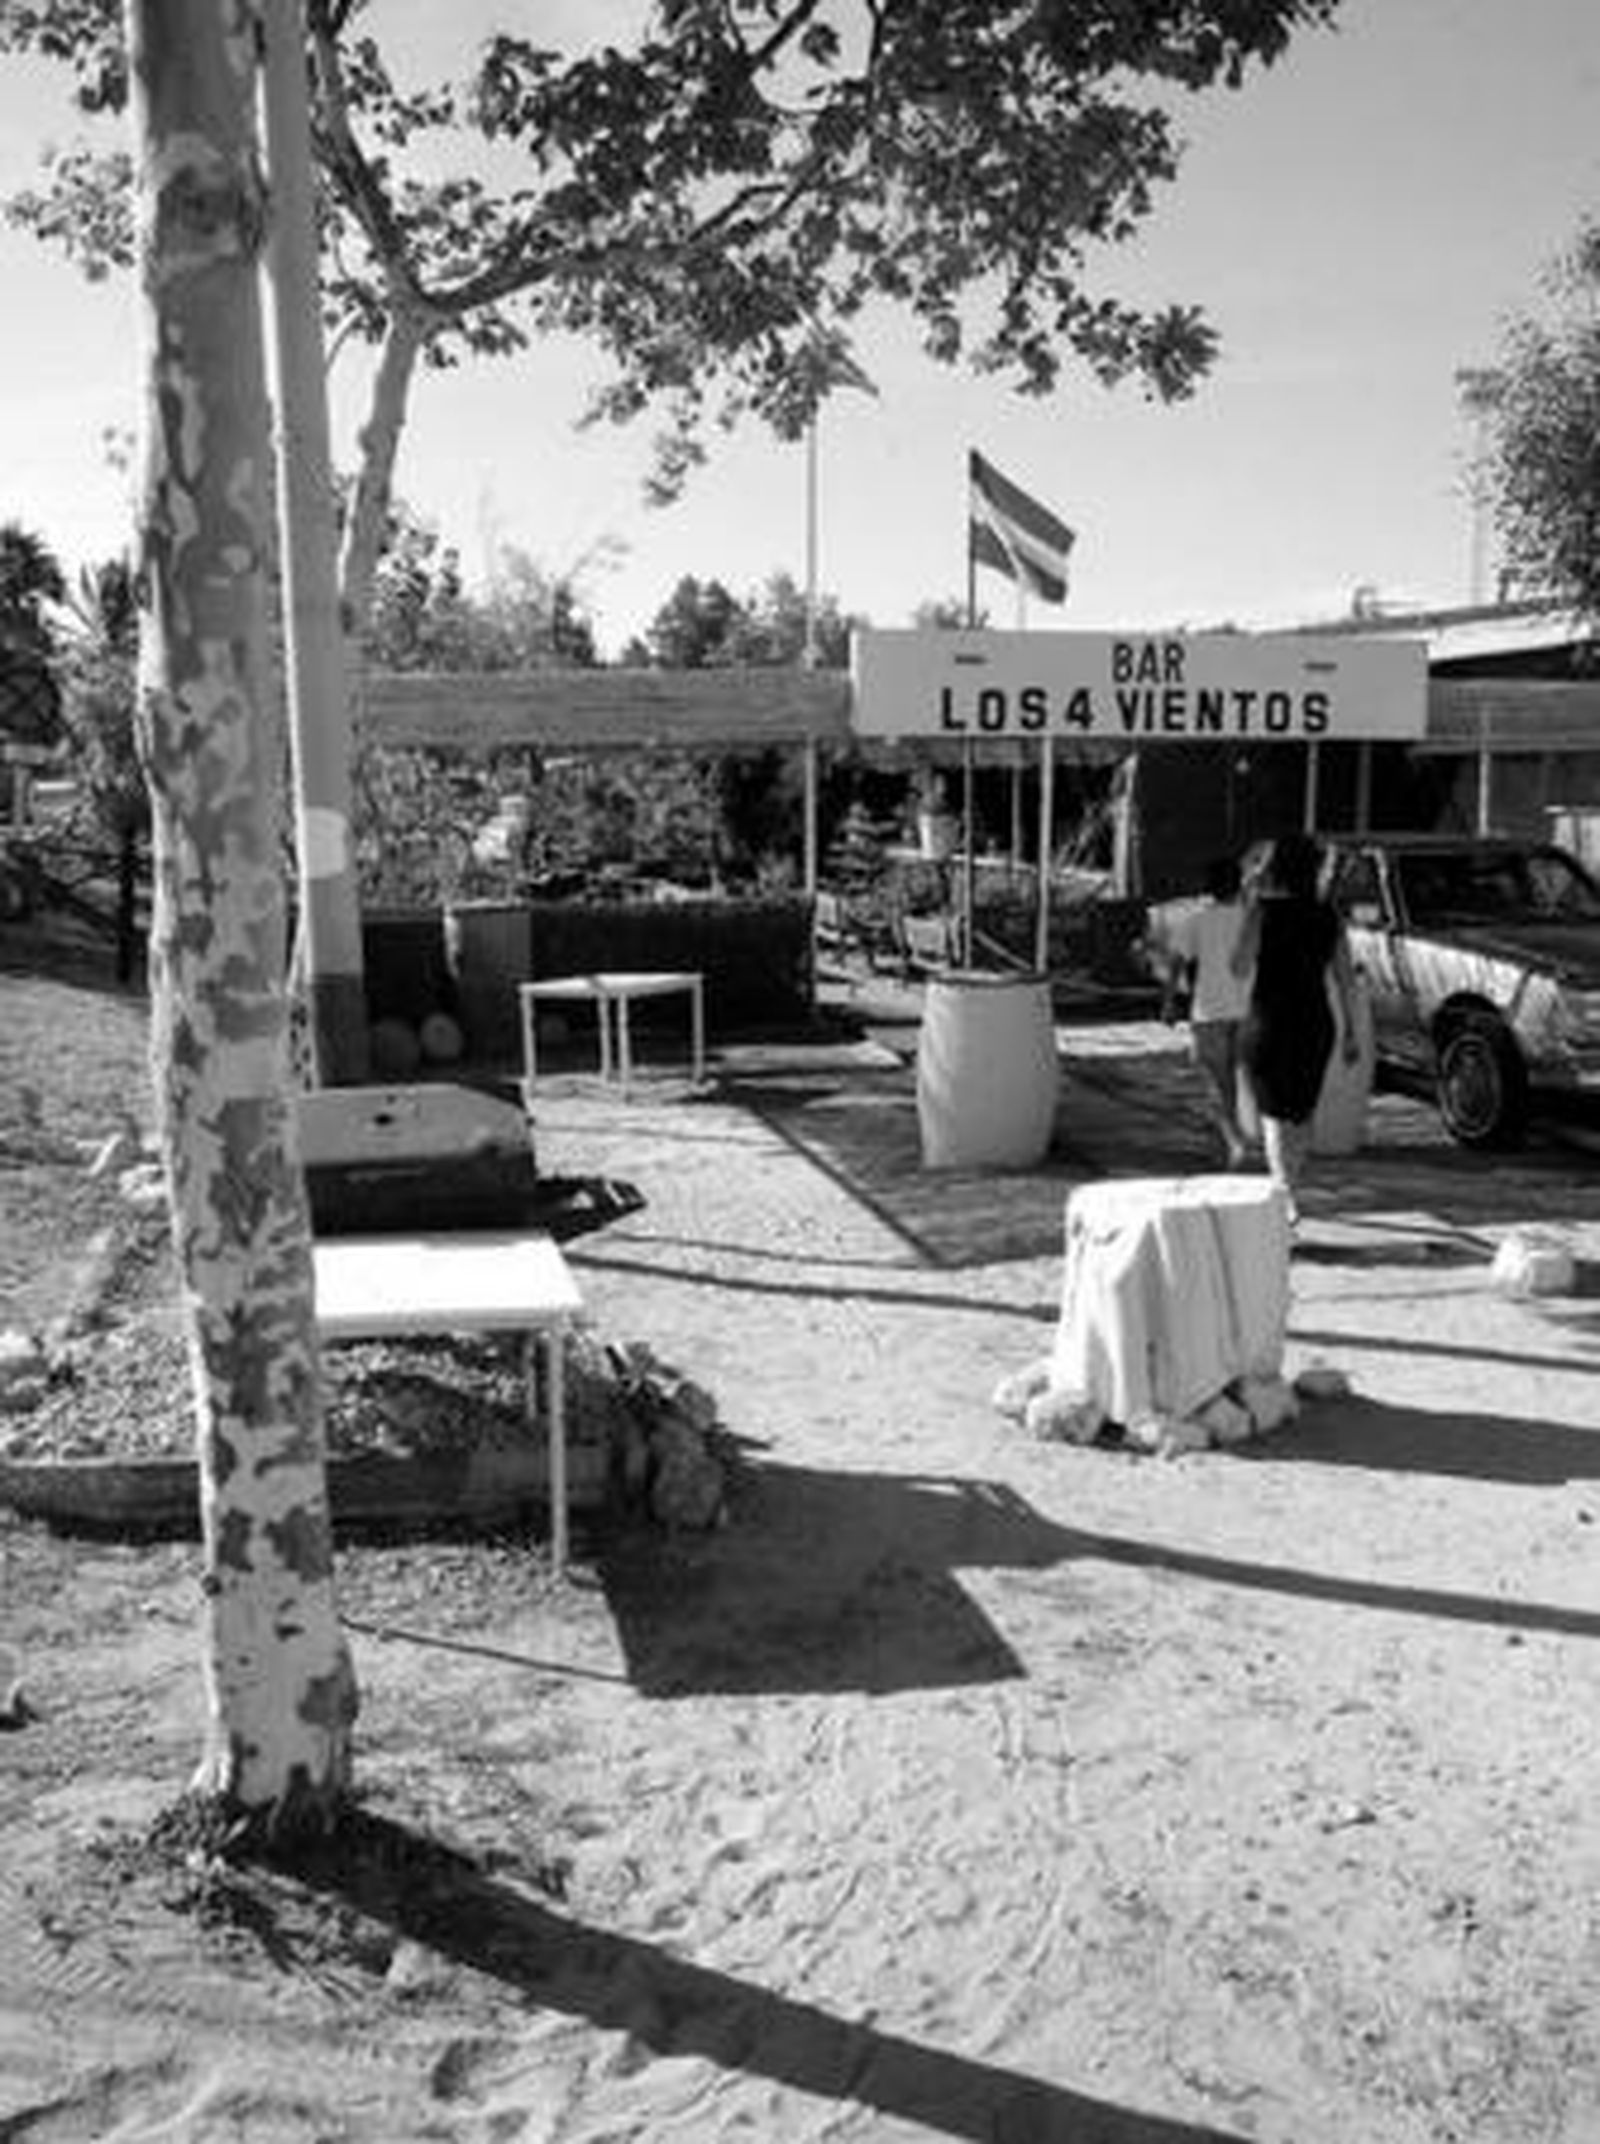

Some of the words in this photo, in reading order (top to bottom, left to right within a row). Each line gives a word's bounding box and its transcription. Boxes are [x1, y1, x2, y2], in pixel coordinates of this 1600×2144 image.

[1112, 642, 1186, 683] BAR
[941, 687, 1048, 732] LOS
[1064, 688, 1095, 731] 4
[1116, 688, 1331, 734] VIENTOS
